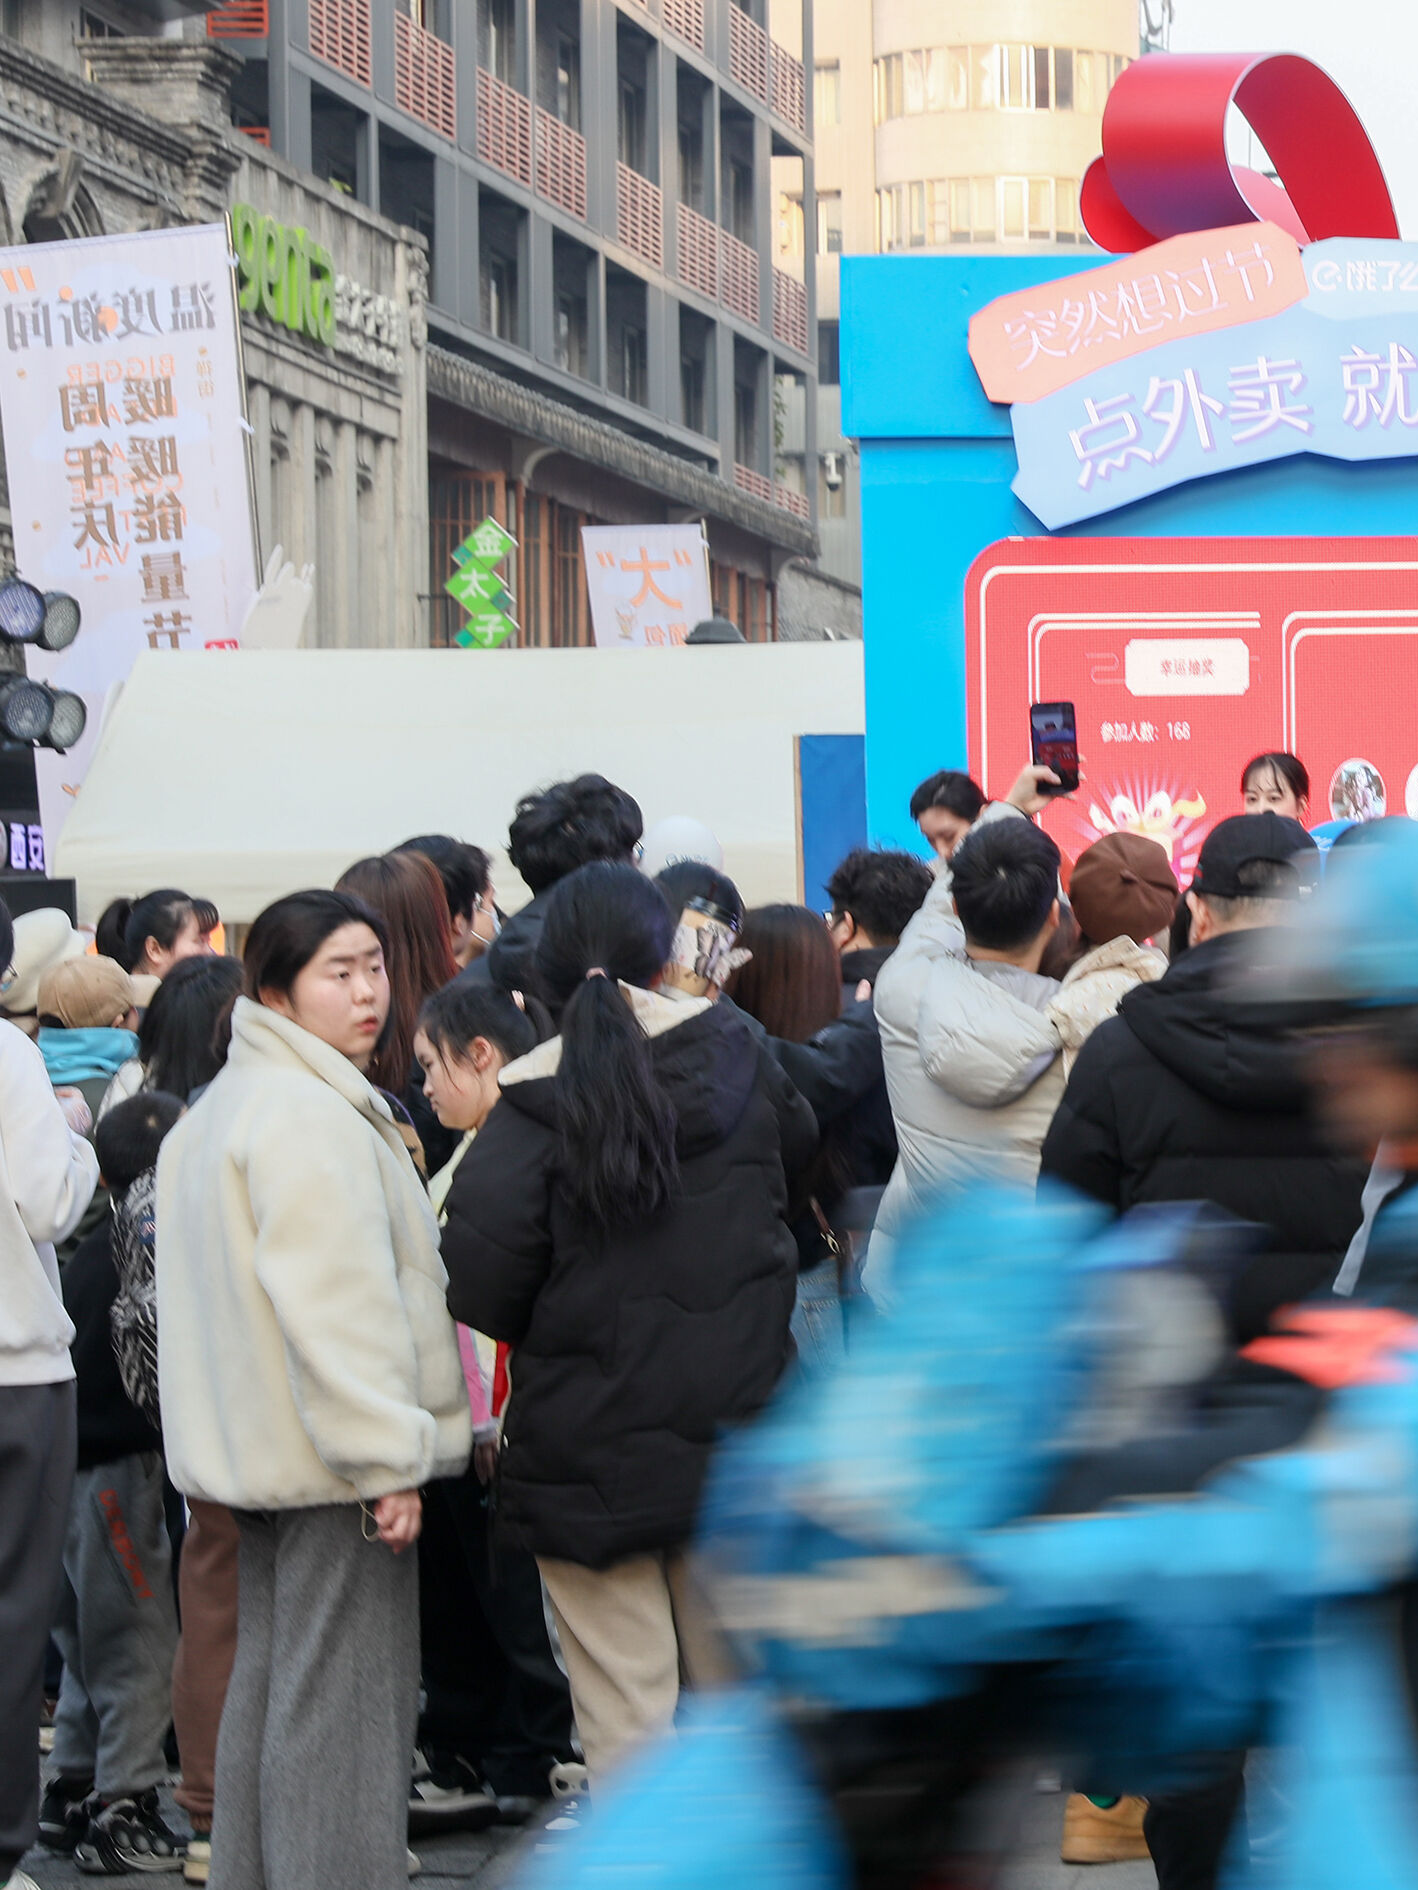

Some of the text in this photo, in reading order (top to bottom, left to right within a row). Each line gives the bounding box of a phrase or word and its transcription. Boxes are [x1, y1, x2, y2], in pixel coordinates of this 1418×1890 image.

[1003, 242, 1275, 371] 突然想过节
[458, 524, 506, 646] 金太子
